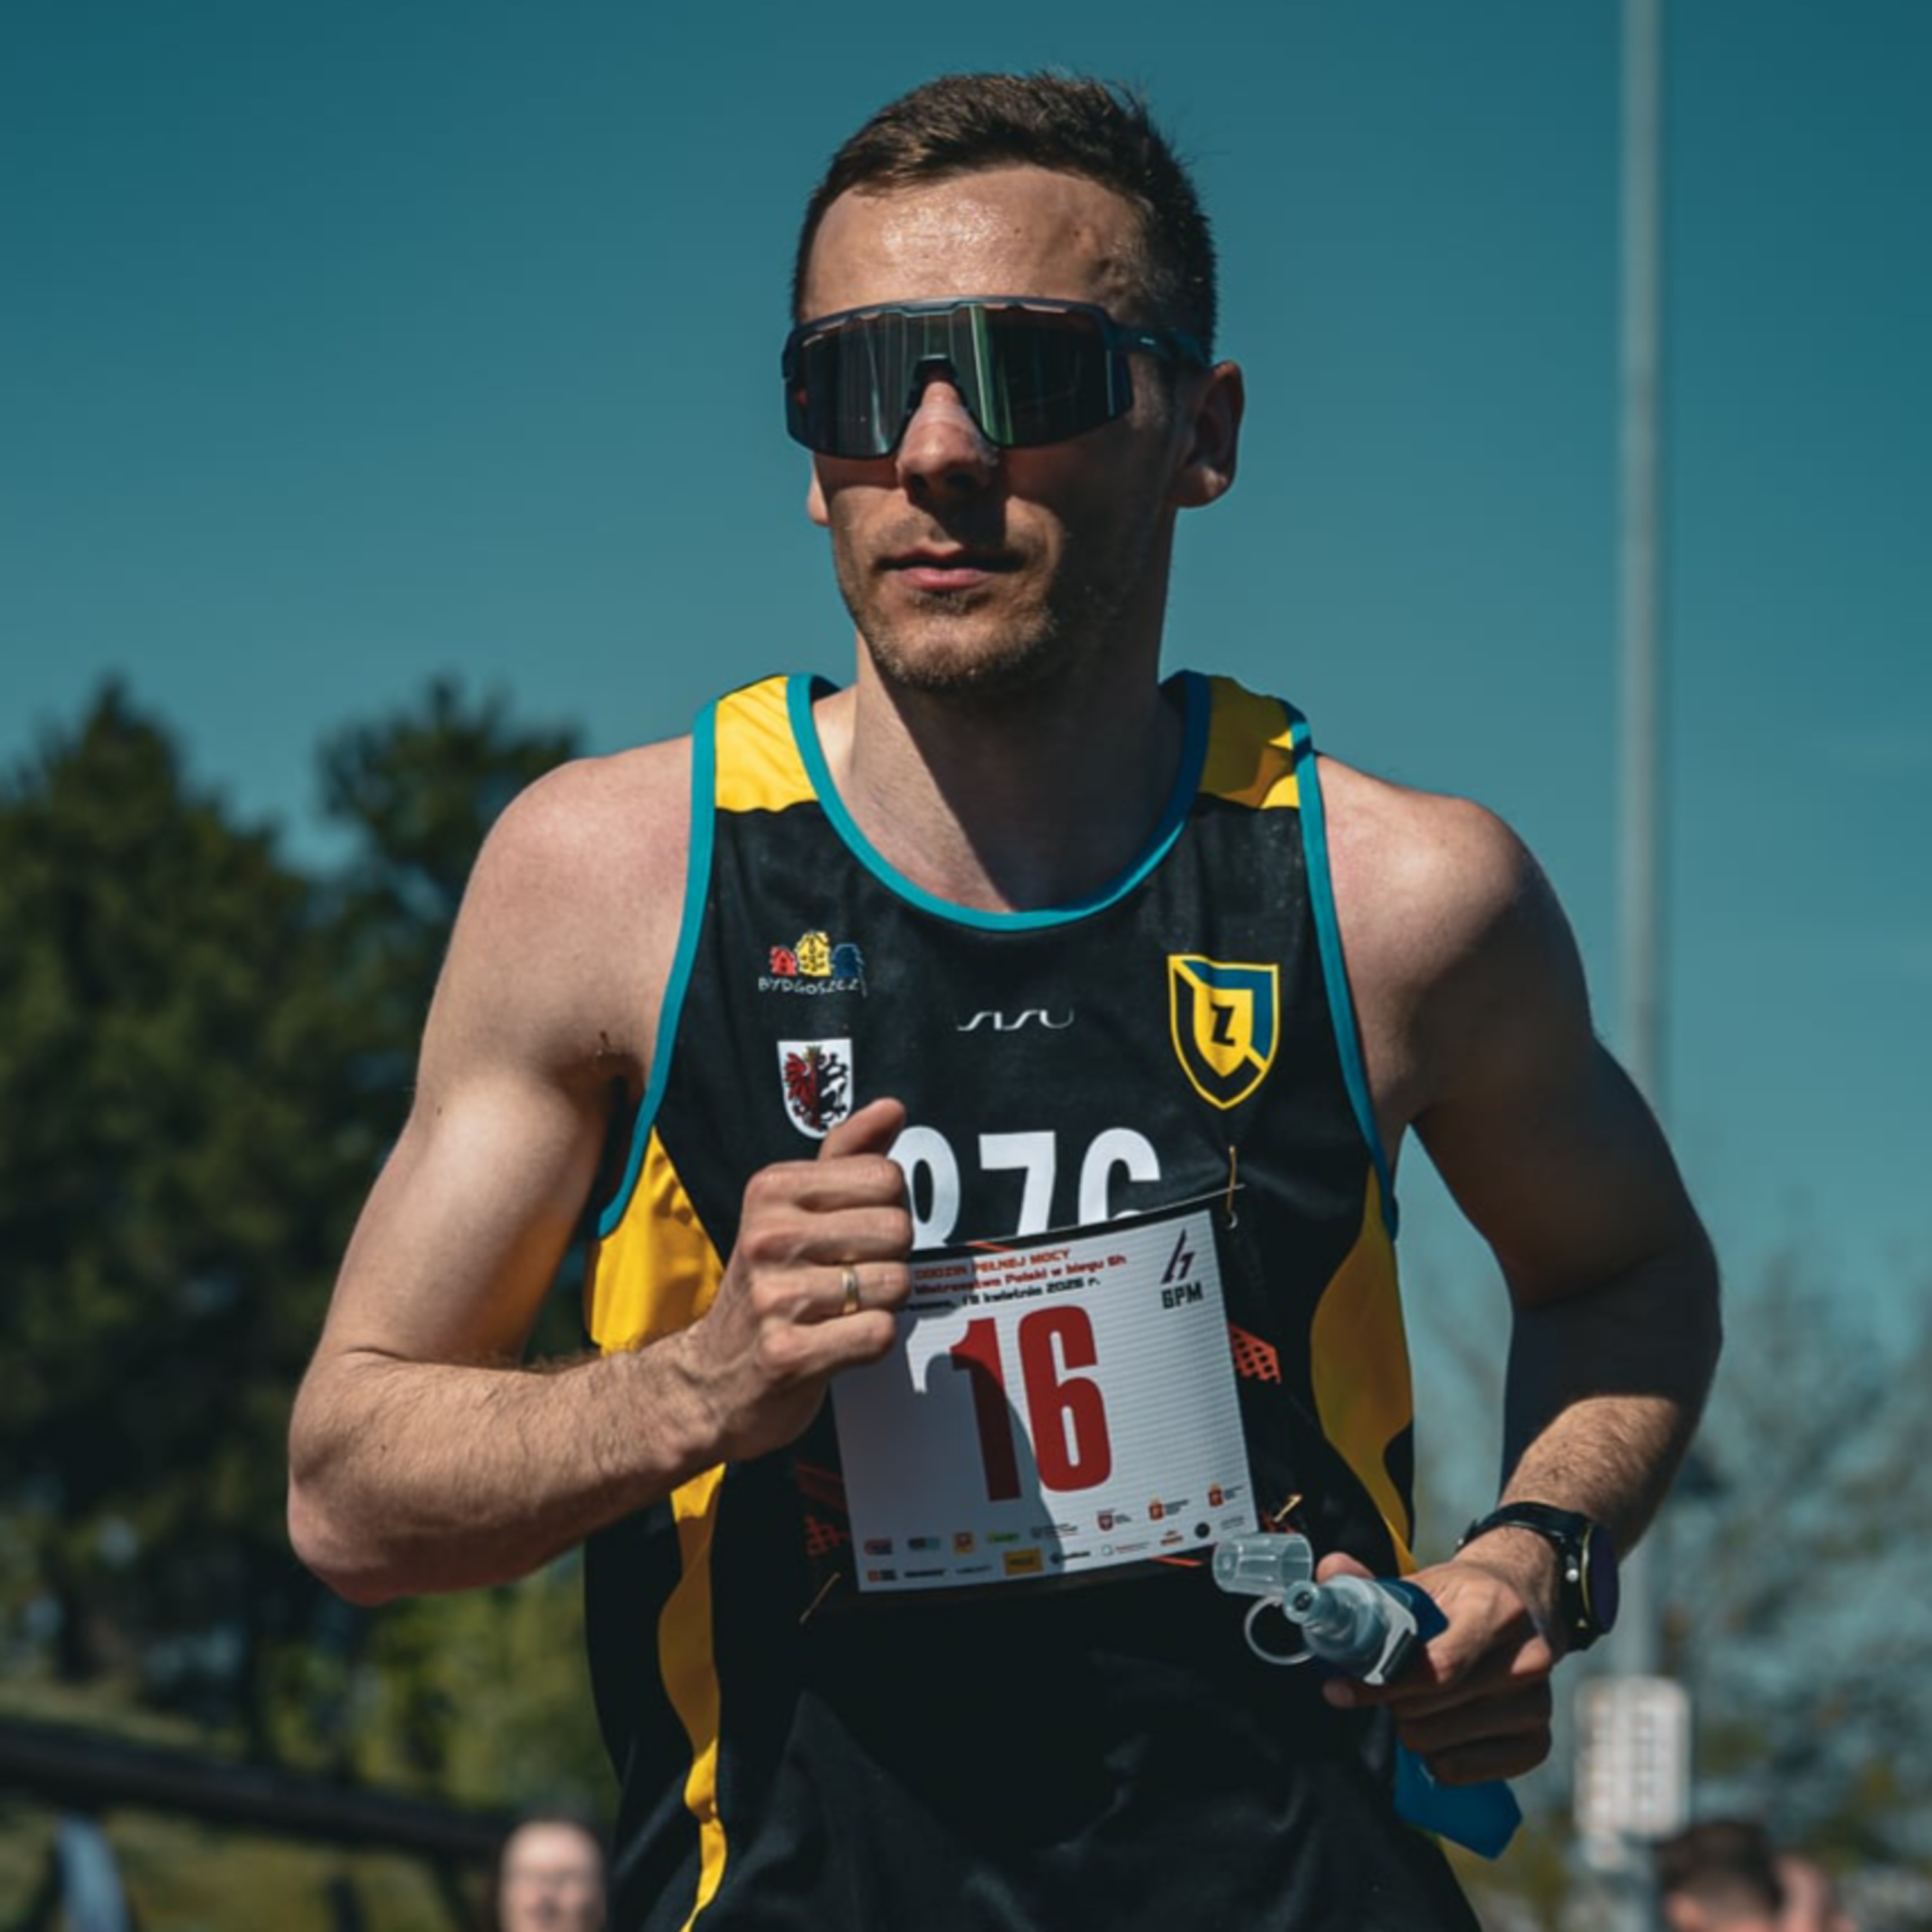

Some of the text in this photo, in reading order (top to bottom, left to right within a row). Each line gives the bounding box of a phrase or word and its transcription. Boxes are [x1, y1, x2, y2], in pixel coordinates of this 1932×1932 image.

[758, 977, 859, 994] BYDGOSZCZ
[1210, 1003, 1235, 1046] Z
[972, 1256, 1026, 1273] PEŁNEJ
[1030, 1248, 1070, 1265] MOCY
[1005, 1267, 1047, 1284] Polski
[1051, 1267, 1062, 1277] w
[1162, 1281, 1203, 1309] GPM
[950, 1305, 1112, 1502] 16
